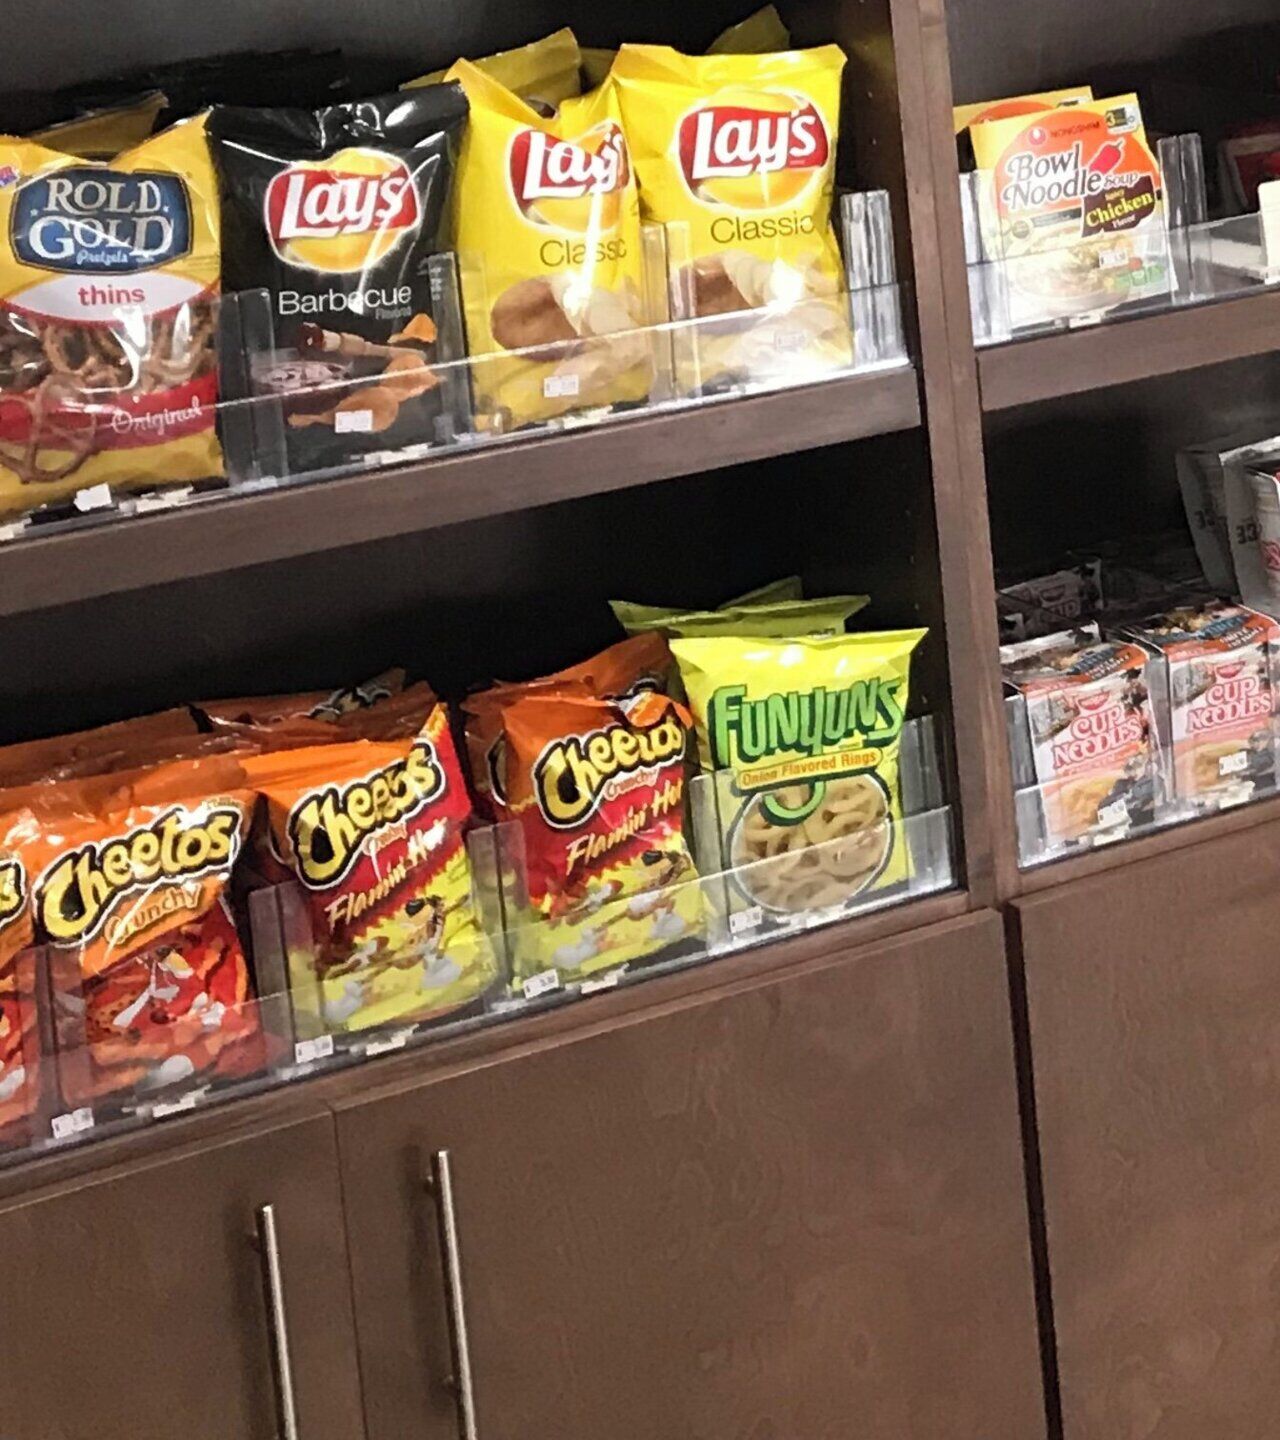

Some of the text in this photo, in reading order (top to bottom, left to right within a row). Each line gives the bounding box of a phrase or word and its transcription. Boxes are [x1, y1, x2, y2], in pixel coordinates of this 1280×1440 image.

[691, 110, 818, 181] Lay's
[1007, 142, 1082, 182] Bowl
[43, 178, 162, 215] ROLD
[278, 170, 405, 240] Lay's
[1003, 169, 1102, 210] Noodle
[1086, 191, 1154, 227] Chicken
[29, 215, 175, 260] GOLD
[710, 212, 816, 244] Classic
[77, 284, 146, 306] thins
[277, 283, 413, 317] Barbecue
[111, 397, 204, 438] Original
[1186, 691, 1274, 732] NOODLES
[1207, 676, 1259, 707] CUP
[711, 677, 902, 768] FUNYUNS
[1071, 703, 1127, 740] CUP
[1051, 715, 1143, 770] NOODLES
[742, 750, 877, 787] Onion Flavored Rings
[42, 812, 236, 940] Cheetos
